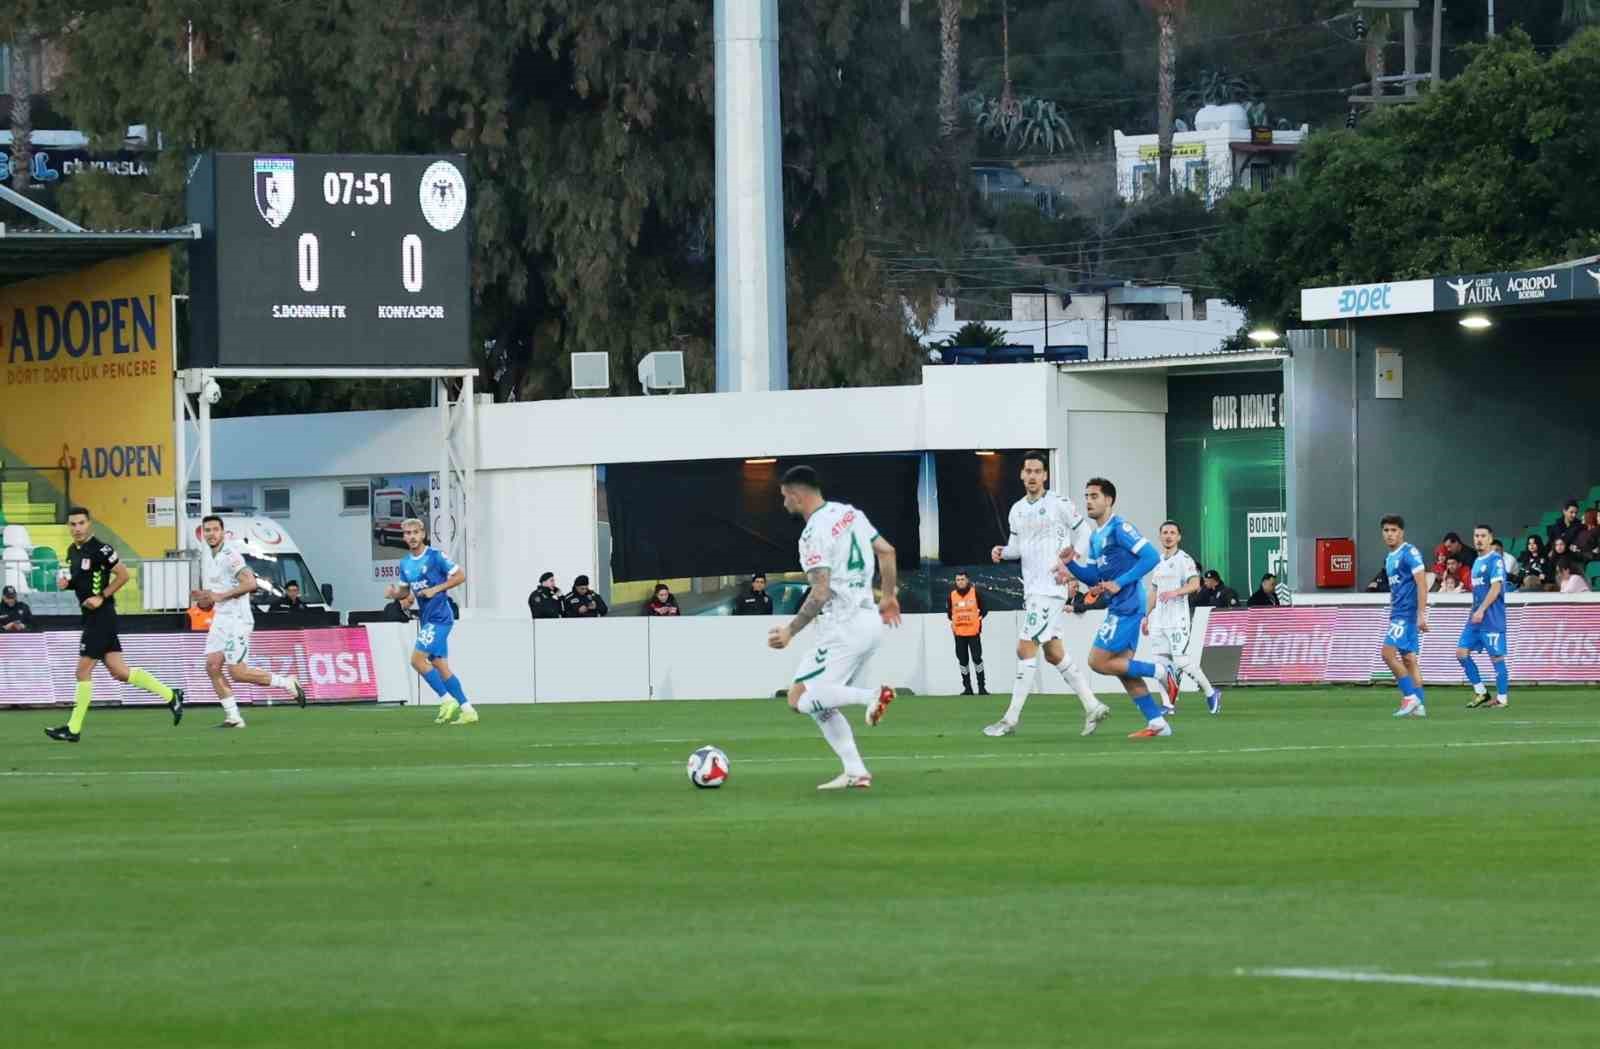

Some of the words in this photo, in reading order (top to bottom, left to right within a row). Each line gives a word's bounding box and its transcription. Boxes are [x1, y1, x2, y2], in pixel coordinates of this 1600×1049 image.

[323, 172, 392, 205] 07:51
[298, 233, 319, 291] 0
[402, 234, 423, 292] 0
[1468, 287, 1502, 305] AURA
[1506, 273, 1558, 292] ACROPOL
[378, 306, 444, 318] KONYASPOR
[8, 295, 157, 363] ADOPEN
[102, 359, 157, 379] PENCERE
[1212, 395, 1238, 430] OUR
[1240, 393, 1276, 428] HOME
[80, 445, 162, 478] ADOPEN
[848, 530, 865, 571] 4
[1388, 623, 1404, 640] 70
